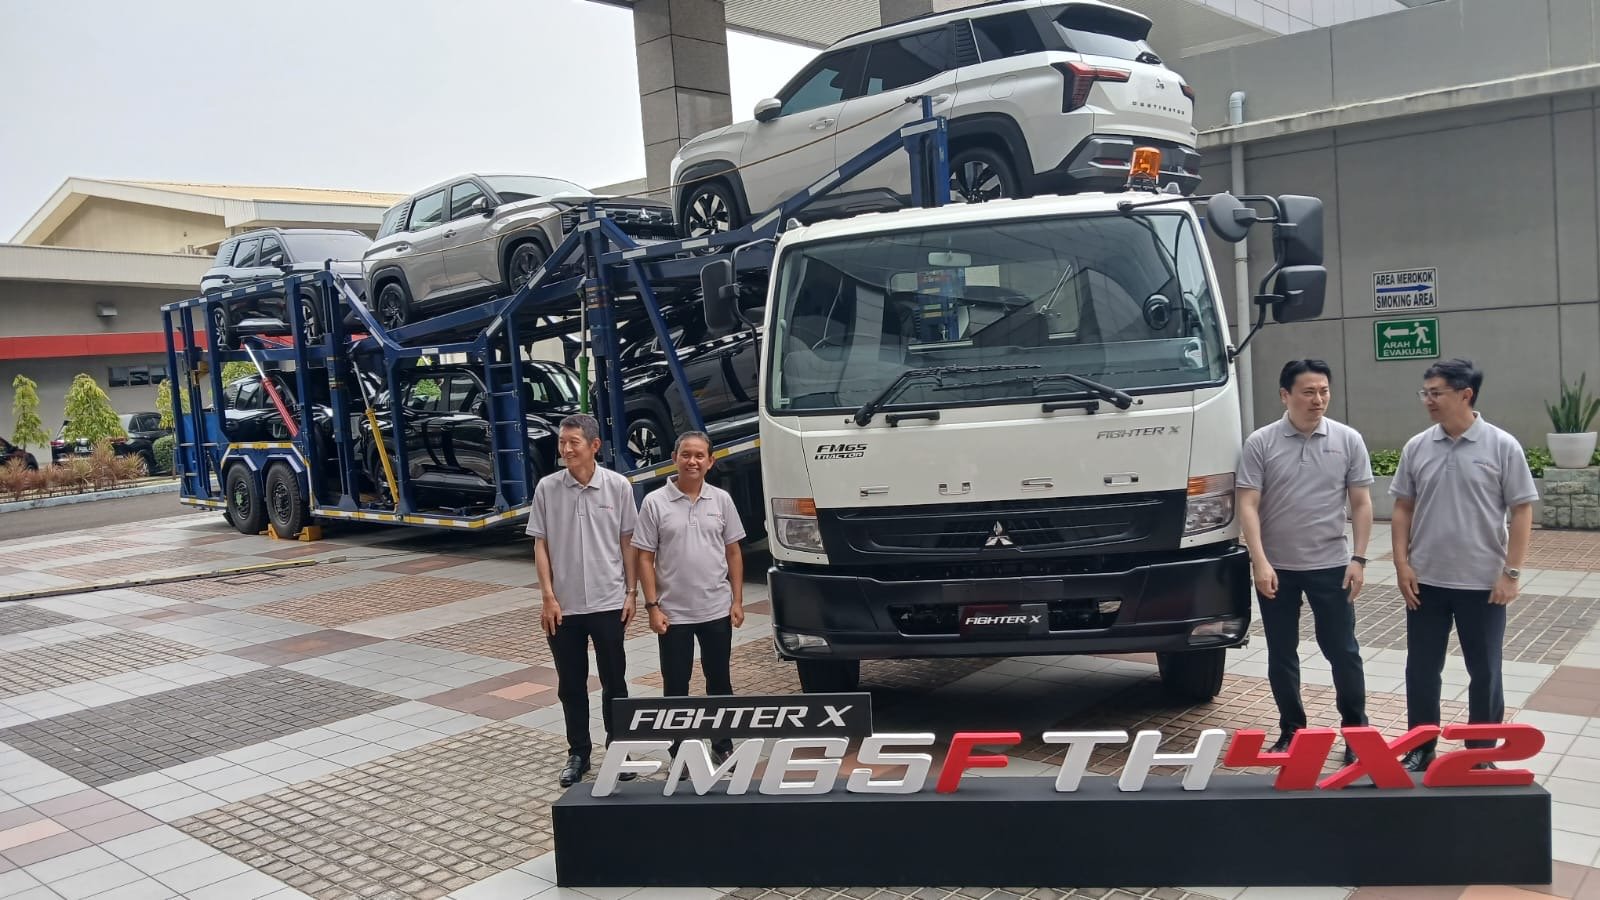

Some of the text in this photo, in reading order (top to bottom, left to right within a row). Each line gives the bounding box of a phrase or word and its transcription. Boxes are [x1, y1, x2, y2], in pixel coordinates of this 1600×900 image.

[1376, 271, 1433, 286] AREA MEROKOK
[1376, 292, 1434, 308] SMOKING AREA
[1383, 341, 1410, 349] ARAH
[1383, 347, 1431, 357] EVAKUASI
[1096, 425, 1180, 439] FIGHTER X
[816, 443, 868, 453] FM65
[814, 452, 864, 460] TRACTOR
[859, 472, 1139, 497] FUSO
[965, 615, 1042, 625] FIGHTER X
[629, 705, 853, 731] FIGHTER X
